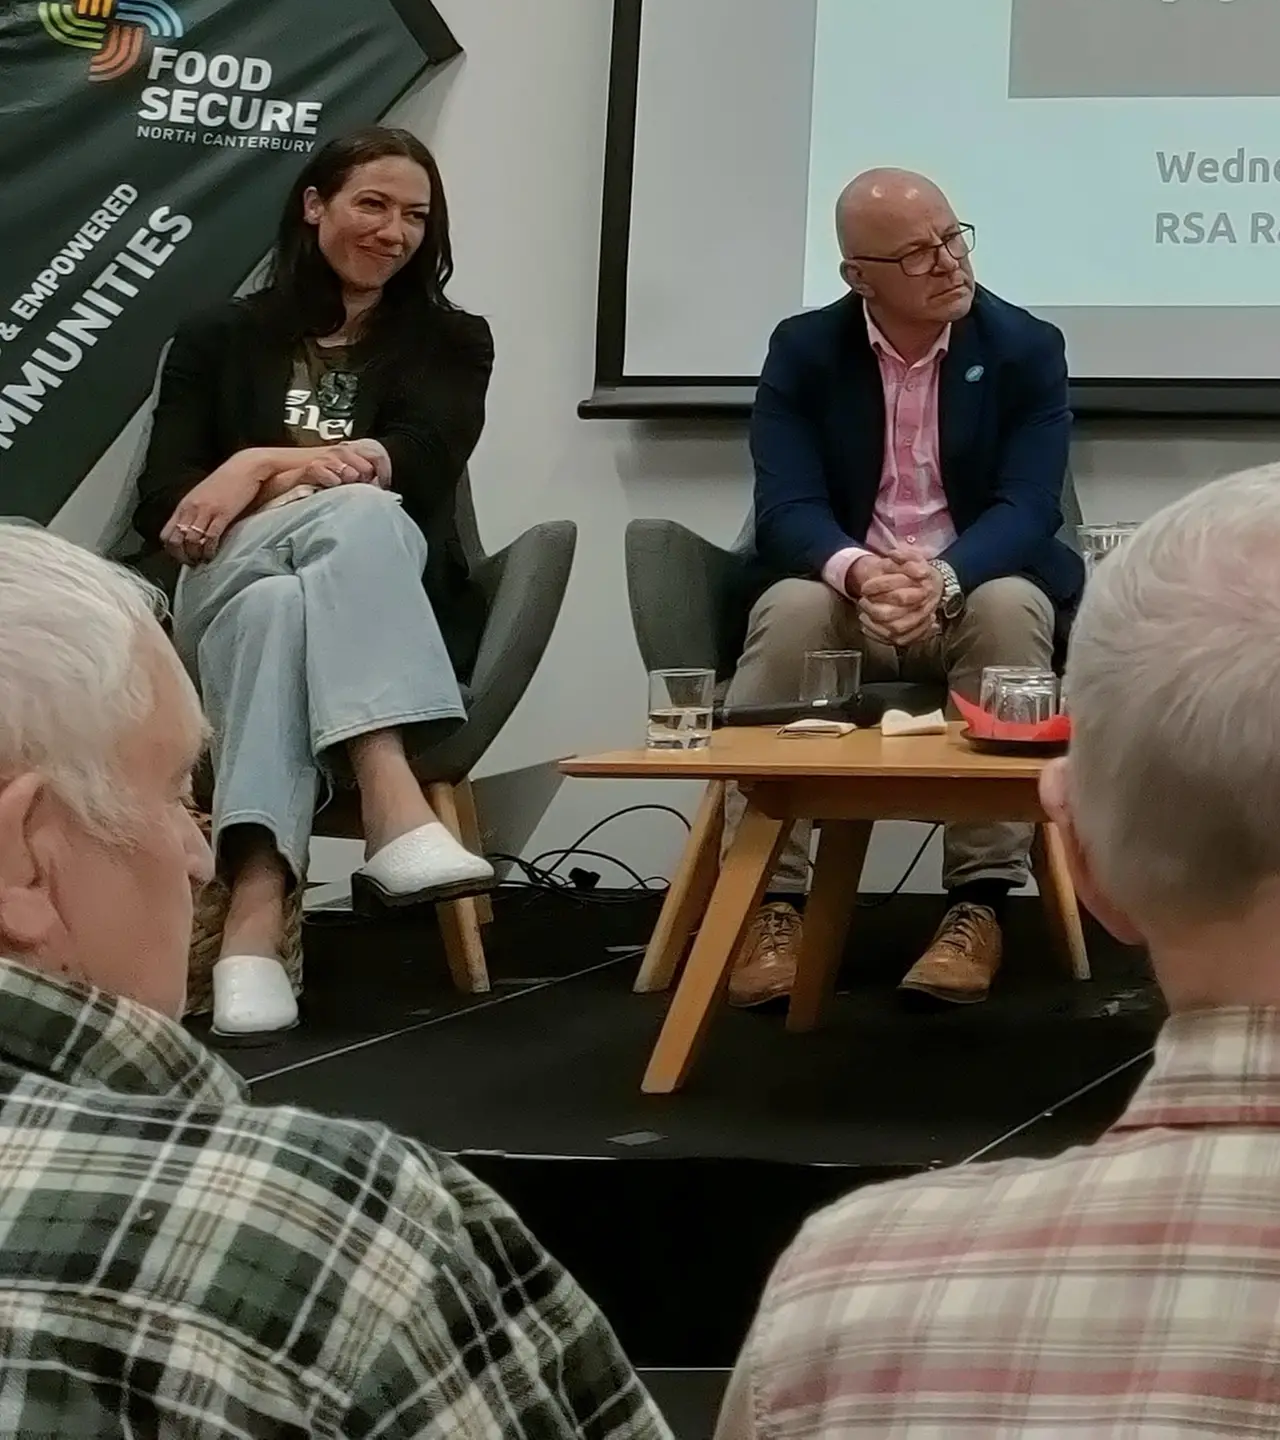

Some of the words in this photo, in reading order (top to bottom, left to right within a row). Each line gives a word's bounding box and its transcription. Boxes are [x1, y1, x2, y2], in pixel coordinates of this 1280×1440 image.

[147, 47, 273, 93] FOOD
[137, 86, 323, 134] SECURE
[136, 125, 197, 144] NORTH
[202, 132, 317, 154] CANTERBURY
[1155, 211, 1237, 244] RSA
[10, 183, 139, 321] EMPOWERED
[0, 205, 193, 451] MMUNITIES
[0, 320, 23, 343] &
